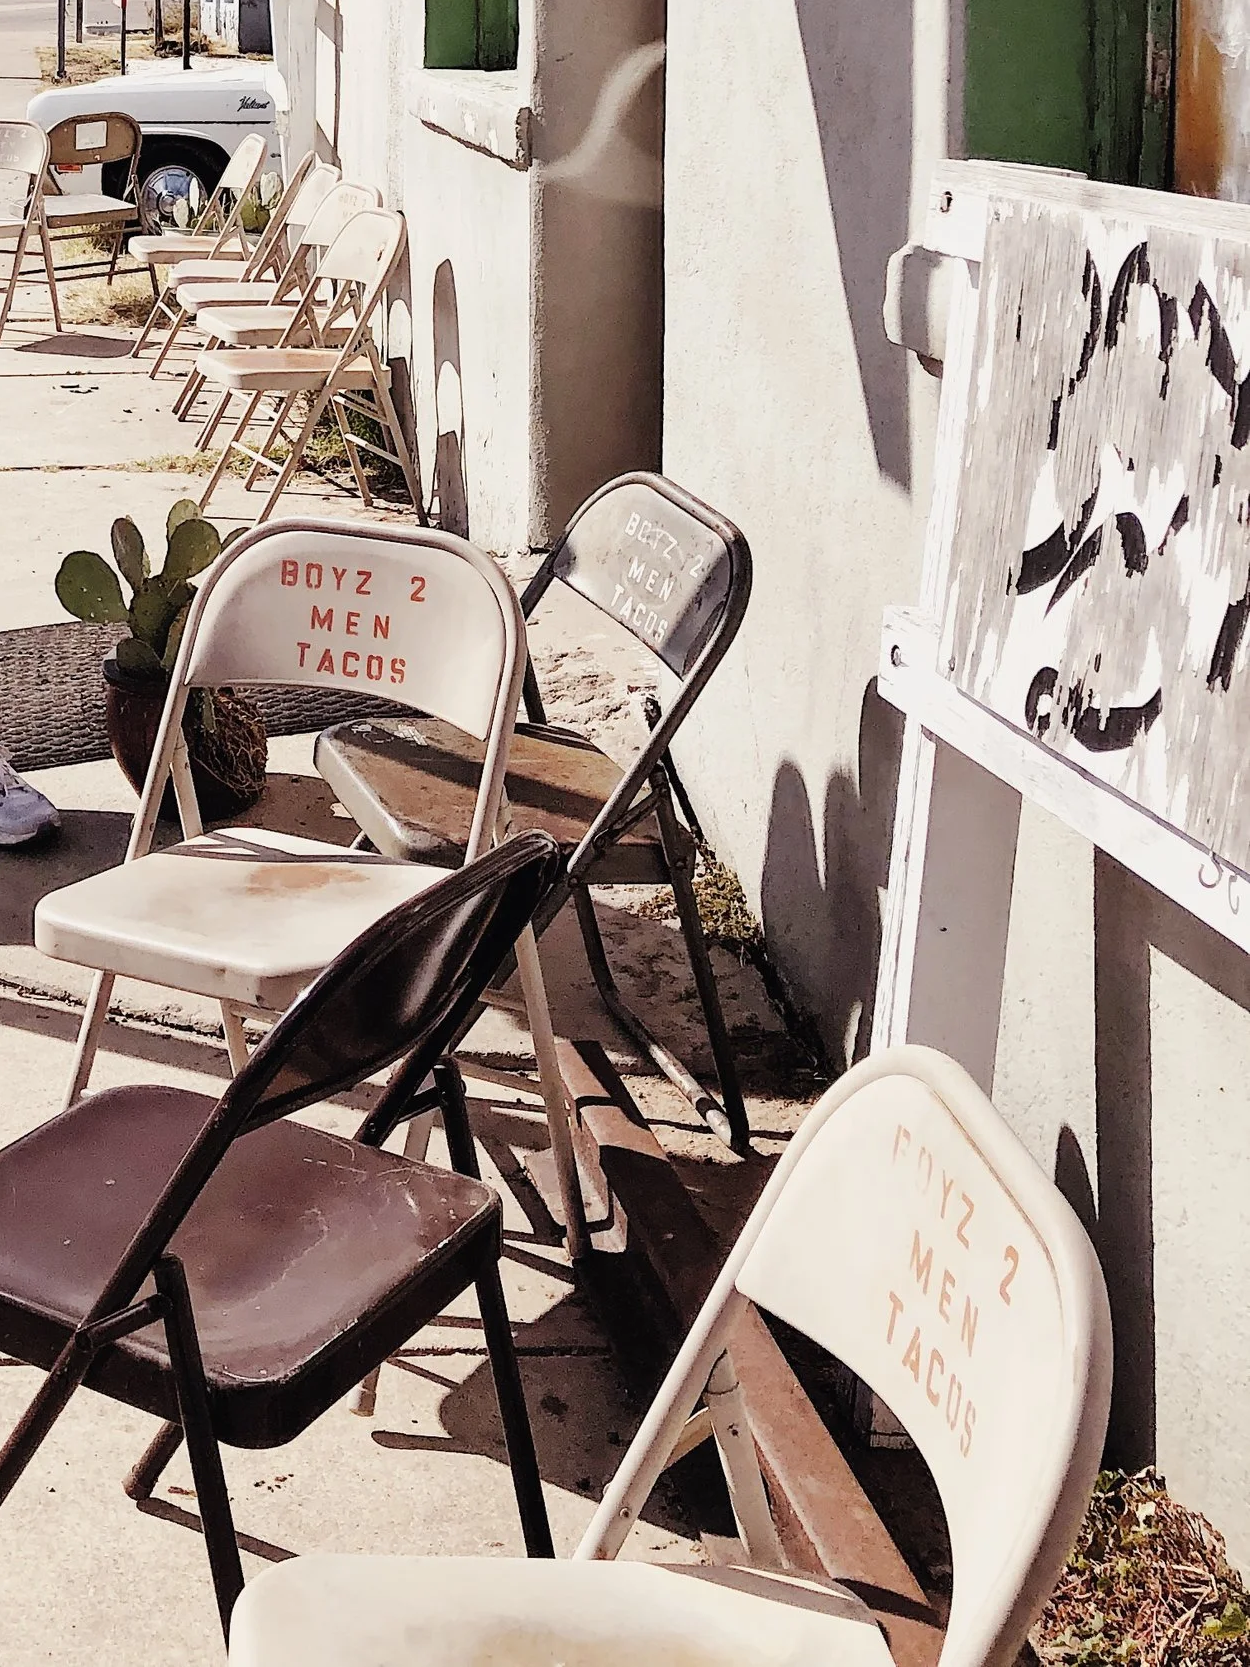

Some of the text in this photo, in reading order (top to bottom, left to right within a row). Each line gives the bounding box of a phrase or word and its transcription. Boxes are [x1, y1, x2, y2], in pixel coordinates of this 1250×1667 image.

[624, 511, 705, 579] BOYZ 2
[280, 558, 427, 603] BOYZ 2
[626, 555, 678, 603] MEN
[310, 604, 390, 640] MEN
[609, 583, 669, 644] TACOS
[296, 641, 407, 684] TACOS
[909, 1229, 979, 1358] MEN
[998, 1244, 1019, 1307] 2
[885, 1290, 977, 1459] TACOS
